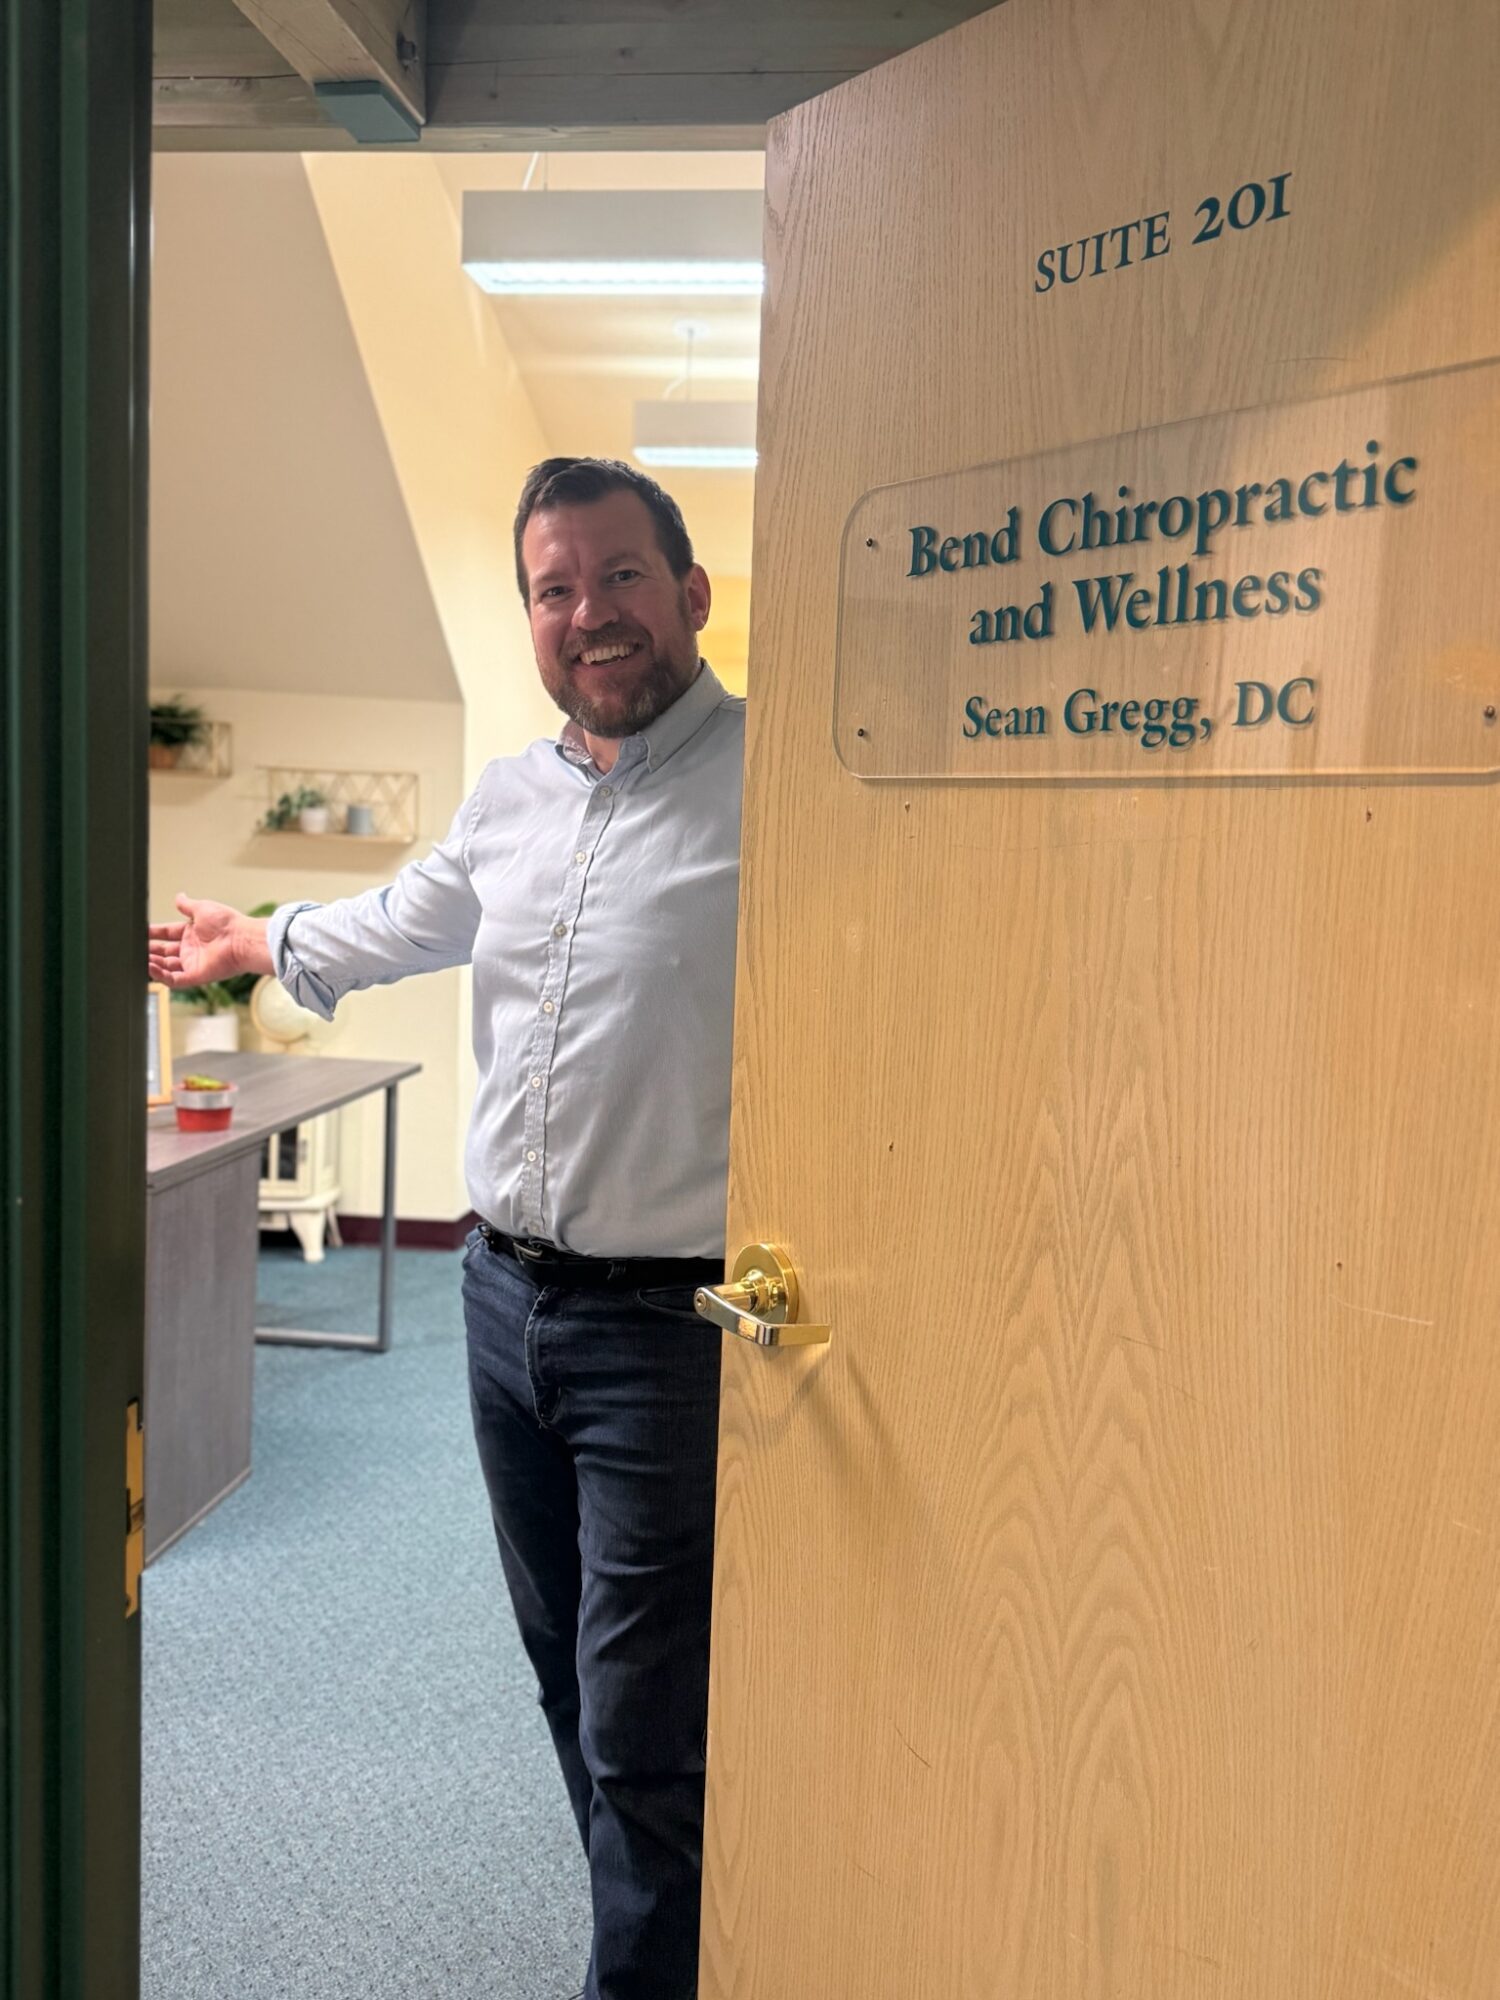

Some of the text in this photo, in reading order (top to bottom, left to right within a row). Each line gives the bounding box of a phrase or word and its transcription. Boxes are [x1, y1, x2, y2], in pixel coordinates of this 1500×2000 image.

[1034, 211, 1171, 293] SUITE
[907, 439, 1418, 577] Bend Chiropractic
[969, 564, 1324, 645] and Wellness
[962, 677, 1316, 747] Sean Gregg, DC
